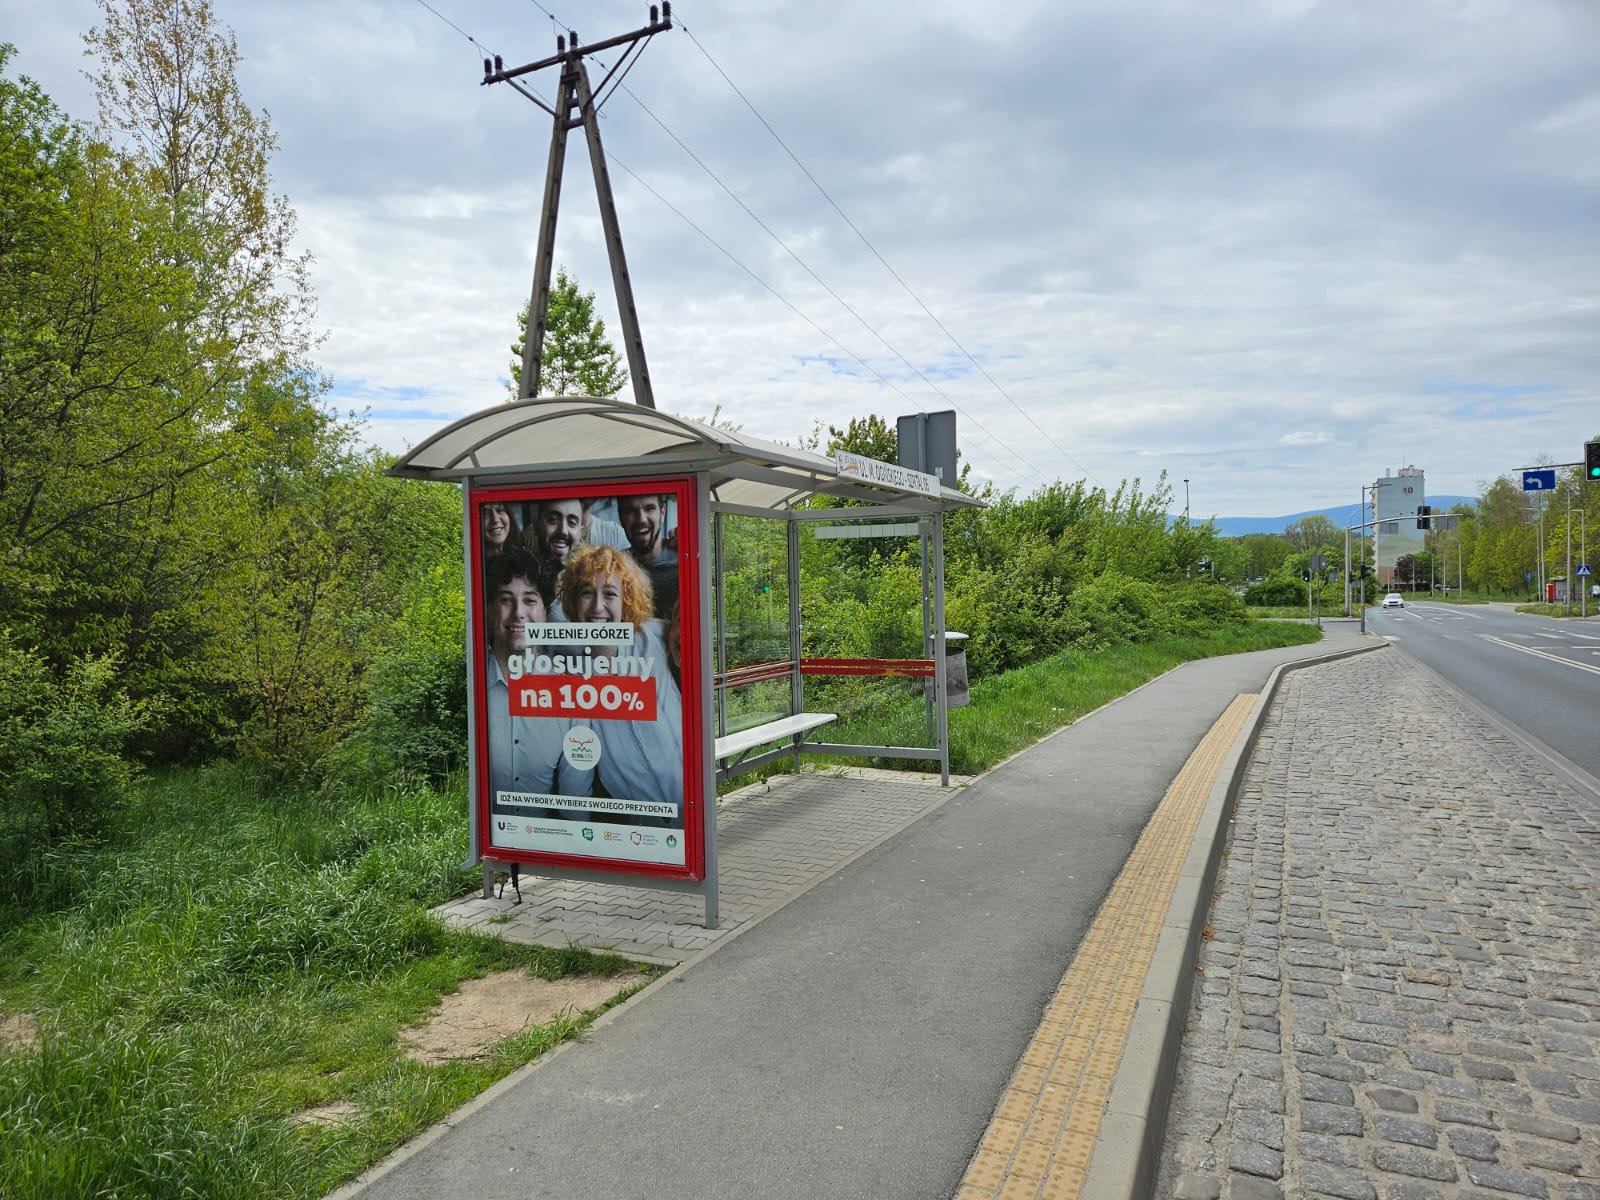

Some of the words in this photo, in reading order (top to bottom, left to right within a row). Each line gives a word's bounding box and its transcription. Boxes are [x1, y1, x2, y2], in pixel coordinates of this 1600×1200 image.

[528, 628, 540, 639] W
[542, 628, 588, 640] JELENIEJ
[591, 626, 630, 640] GÓRZE
[507, 646, 656, 682] głosujemy
[520, 688, 552, 708] na
[559, 684, 645, 711] 100%
[500, 794, 511, 802] IDŹ
[512, 795, 523, 803] NA
[555, 798, 588, 808] WYBIERZ
[589, 800, 624, 810] SWOJEGO
[625, 803, 673, 814] PREZYDENTA
